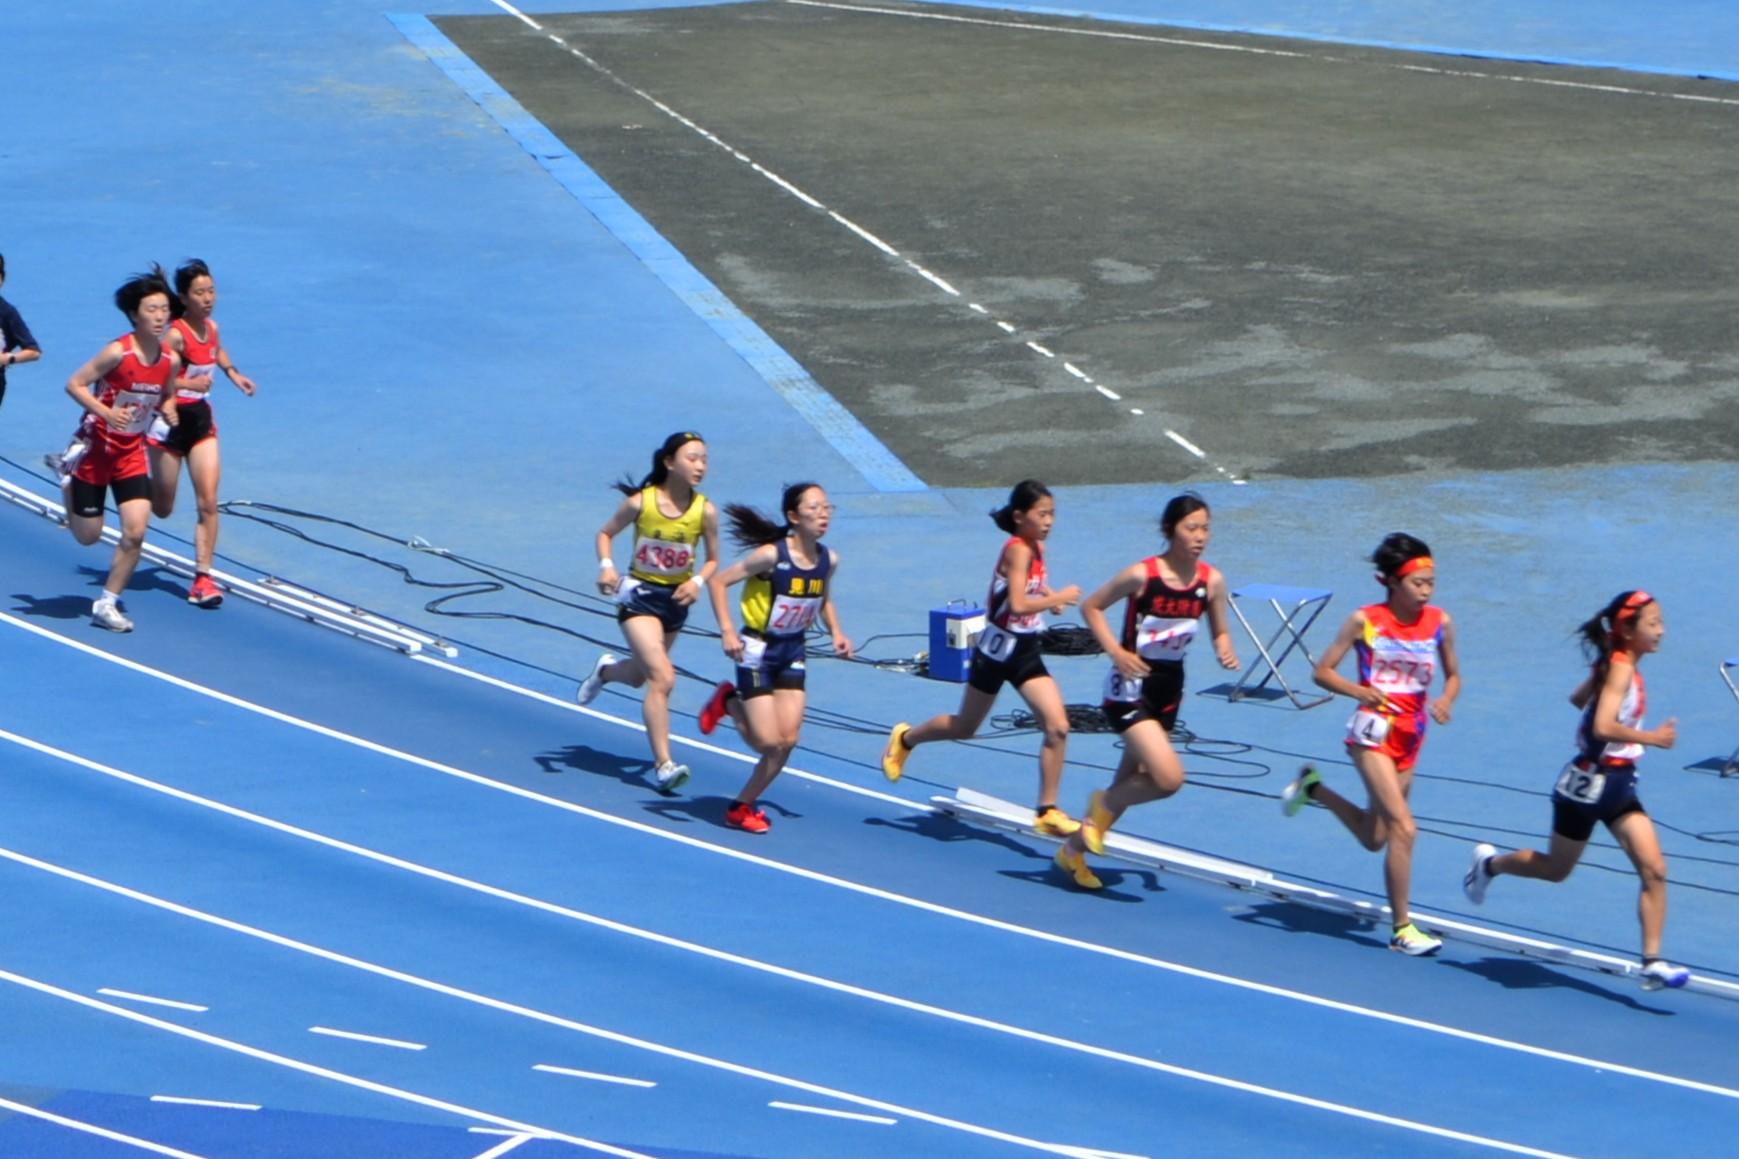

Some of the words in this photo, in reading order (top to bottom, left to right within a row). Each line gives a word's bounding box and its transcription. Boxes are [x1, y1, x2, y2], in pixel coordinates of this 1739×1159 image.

[636, 544, 689, 569] 4388
[1374, 659, 1433, 686] 2573
[1361, 718, 1375, 740] 4
[1565, 770, 1592, 798] 12
